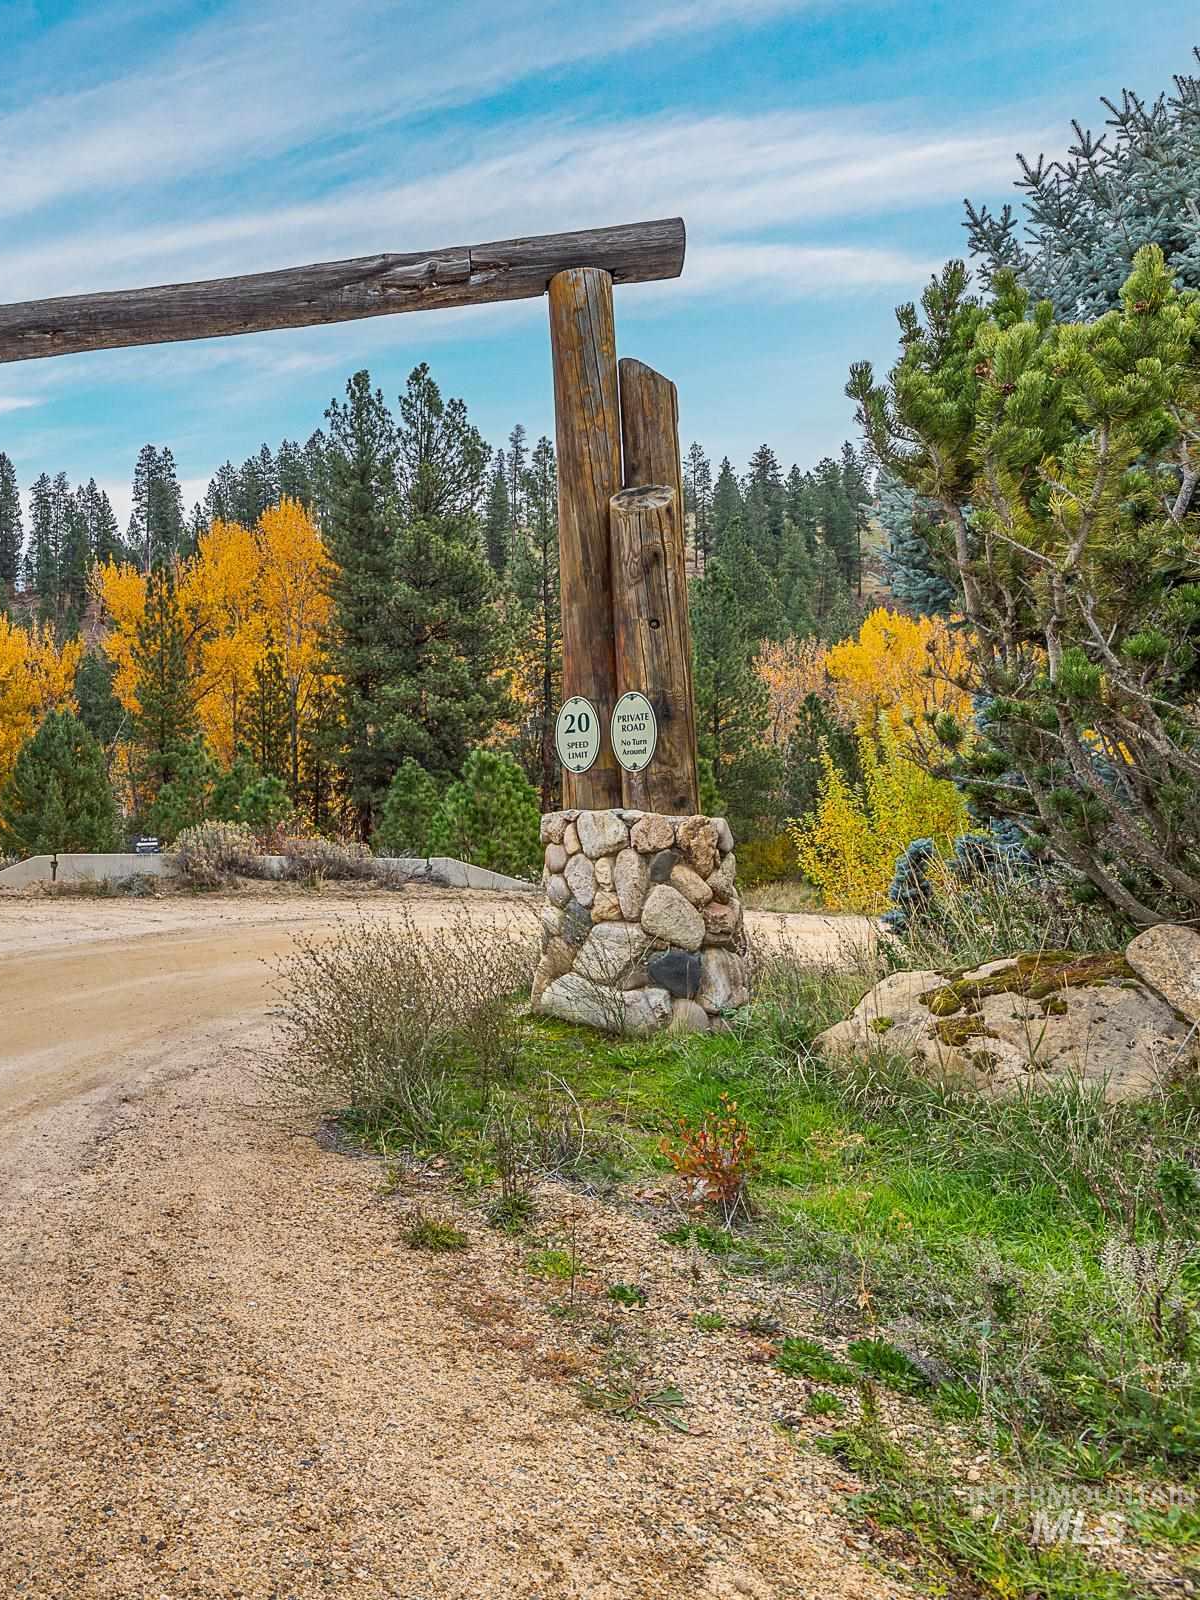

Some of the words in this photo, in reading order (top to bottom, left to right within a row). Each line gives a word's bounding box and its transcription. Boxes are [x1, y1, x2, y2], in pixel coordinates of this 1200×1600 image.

[617, 713, 649, 723] PRIVATE
[564, 712, 590, 734] 20
[621, 723, 646, 733] ROAD
[567, 741, 589, 749] SPEED
[568, 751, 588, 760] LIMIT
[622, 747, 647, 756] Around
